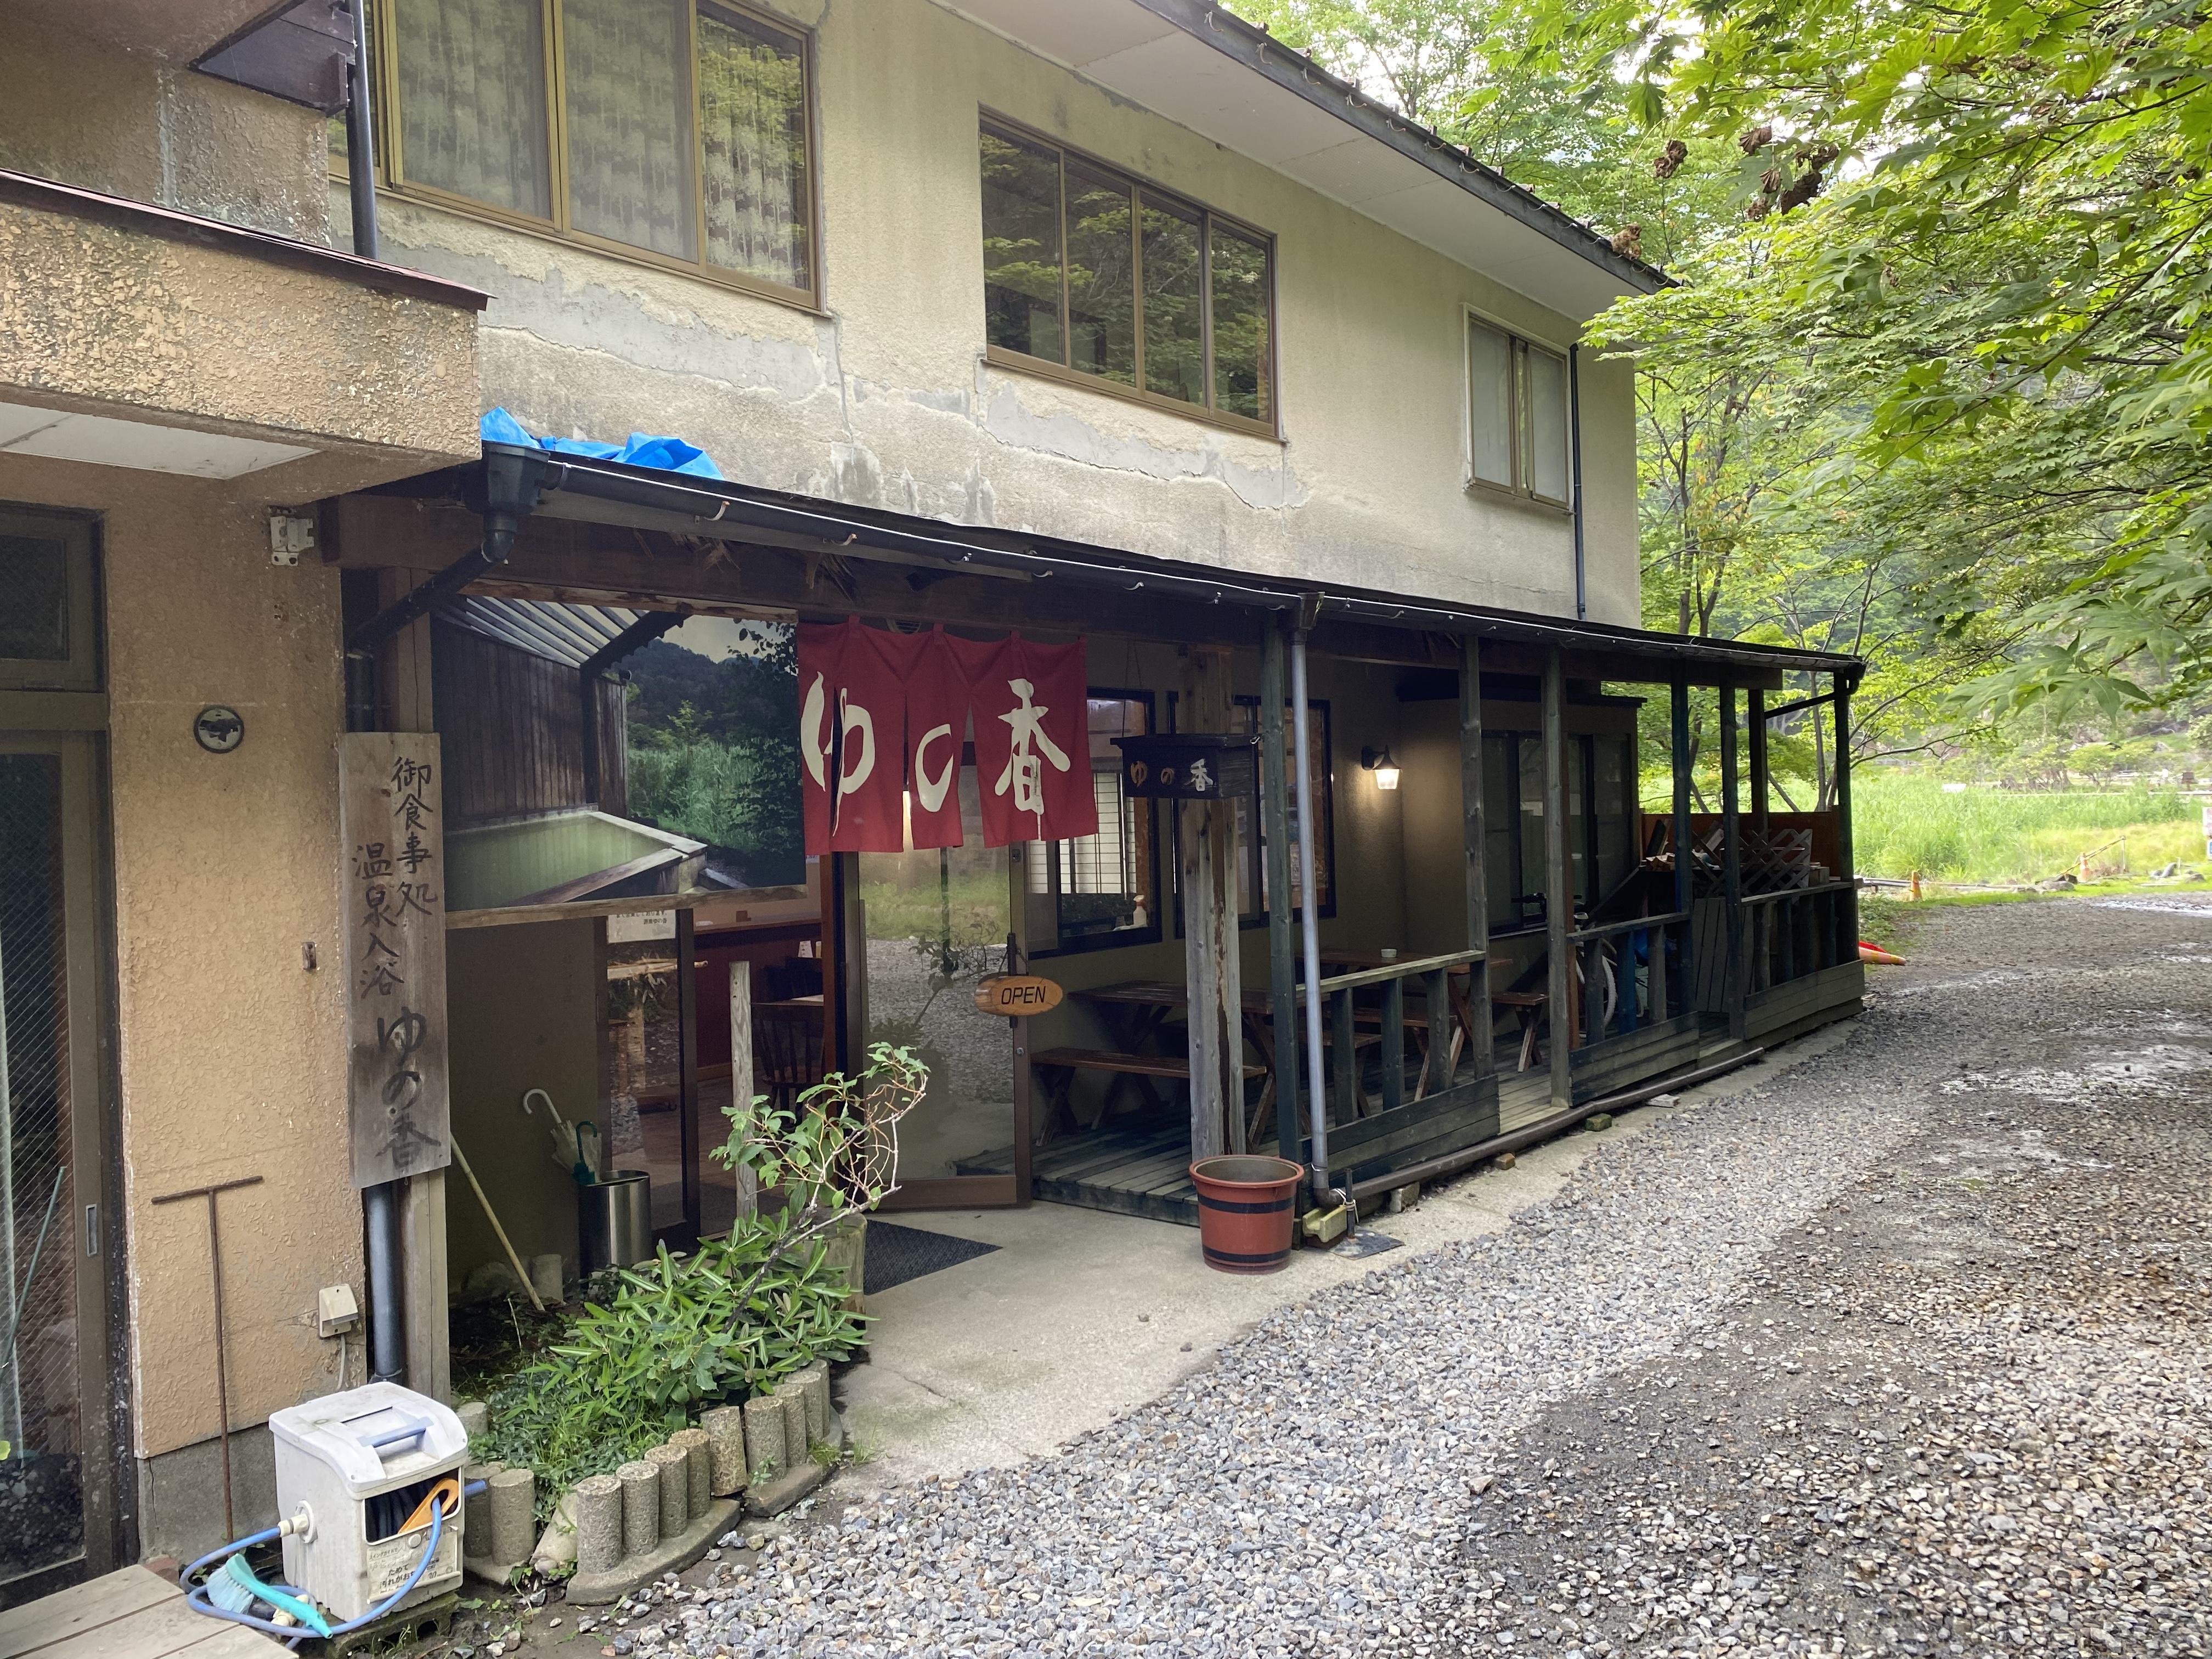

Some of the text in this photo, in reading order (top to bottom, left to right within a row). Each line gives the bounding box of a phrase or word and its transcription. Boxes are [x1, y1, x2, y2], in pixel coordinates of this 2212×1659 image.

[391, 756, 438, 917] 御食事処
[1130, 758, 1214, 792] ゆの香
[352, 844, 404, 999] 温泉入浴
[1001, 986, 1046, 1005] OPEN
[375, 1006, 441, 1171] ゆの香
